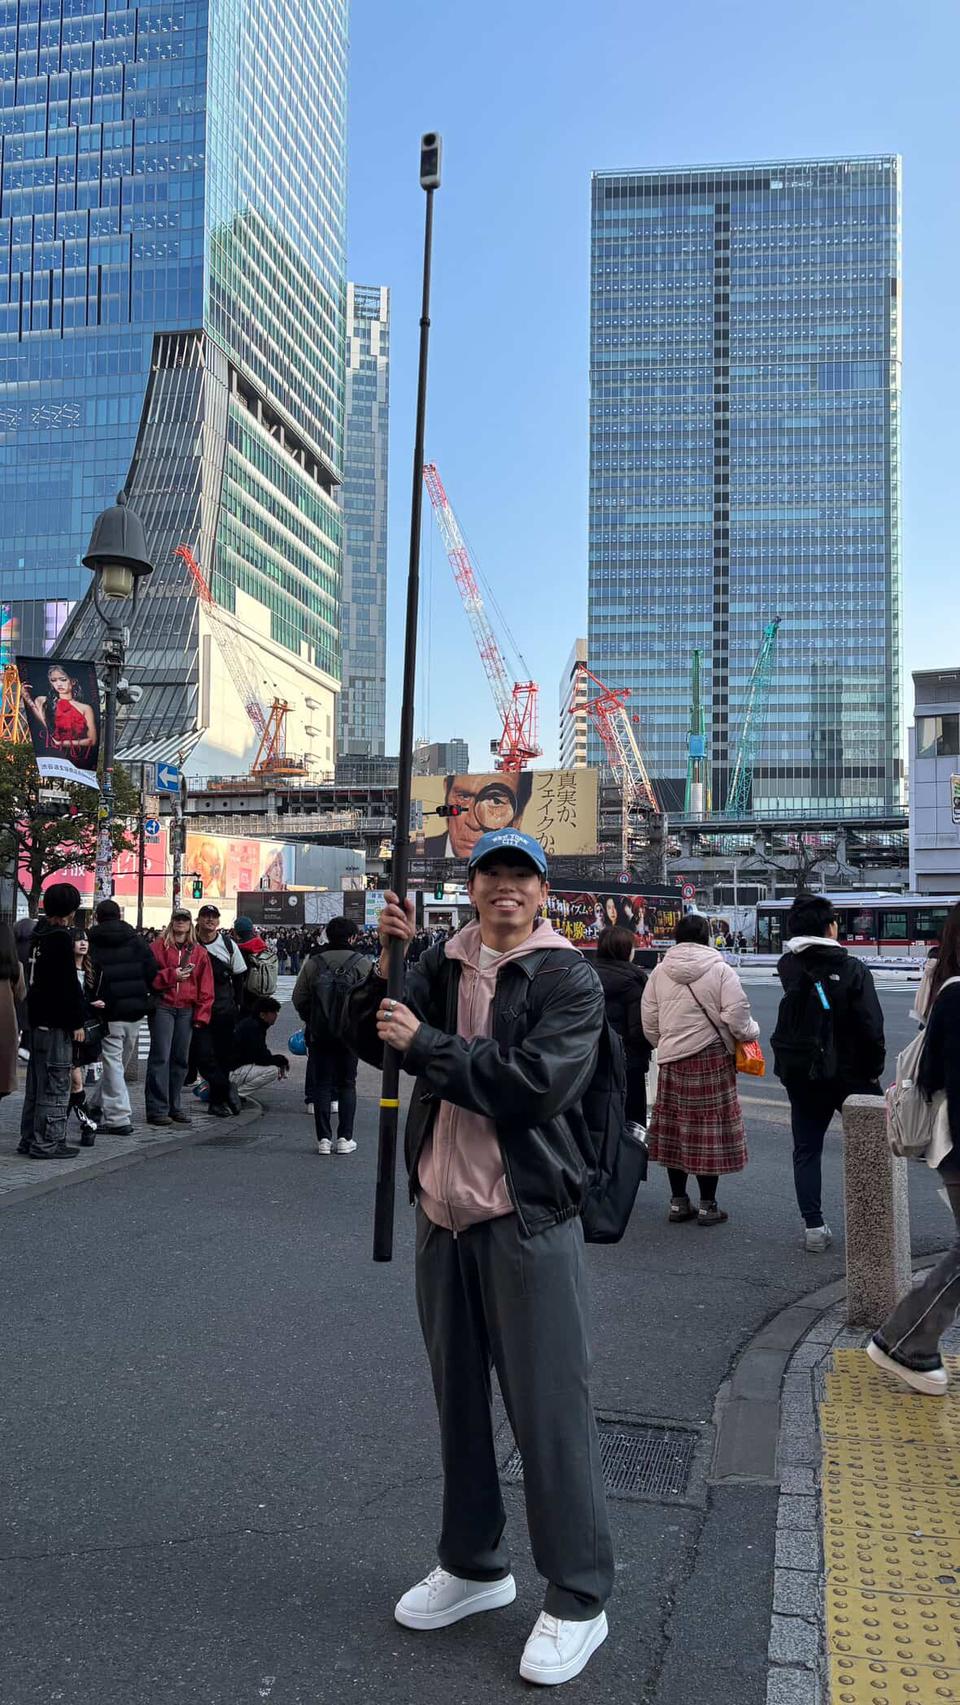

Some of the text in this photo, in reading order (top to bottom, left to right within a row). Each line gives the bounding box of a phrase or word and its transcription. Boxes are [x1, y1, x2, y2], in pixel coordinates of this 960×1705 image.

[536, 773, 555, 854] フェイクか。
[556, 772, 577, 828] 真実か、
[492, 834, 529, 845] NEW YORK
